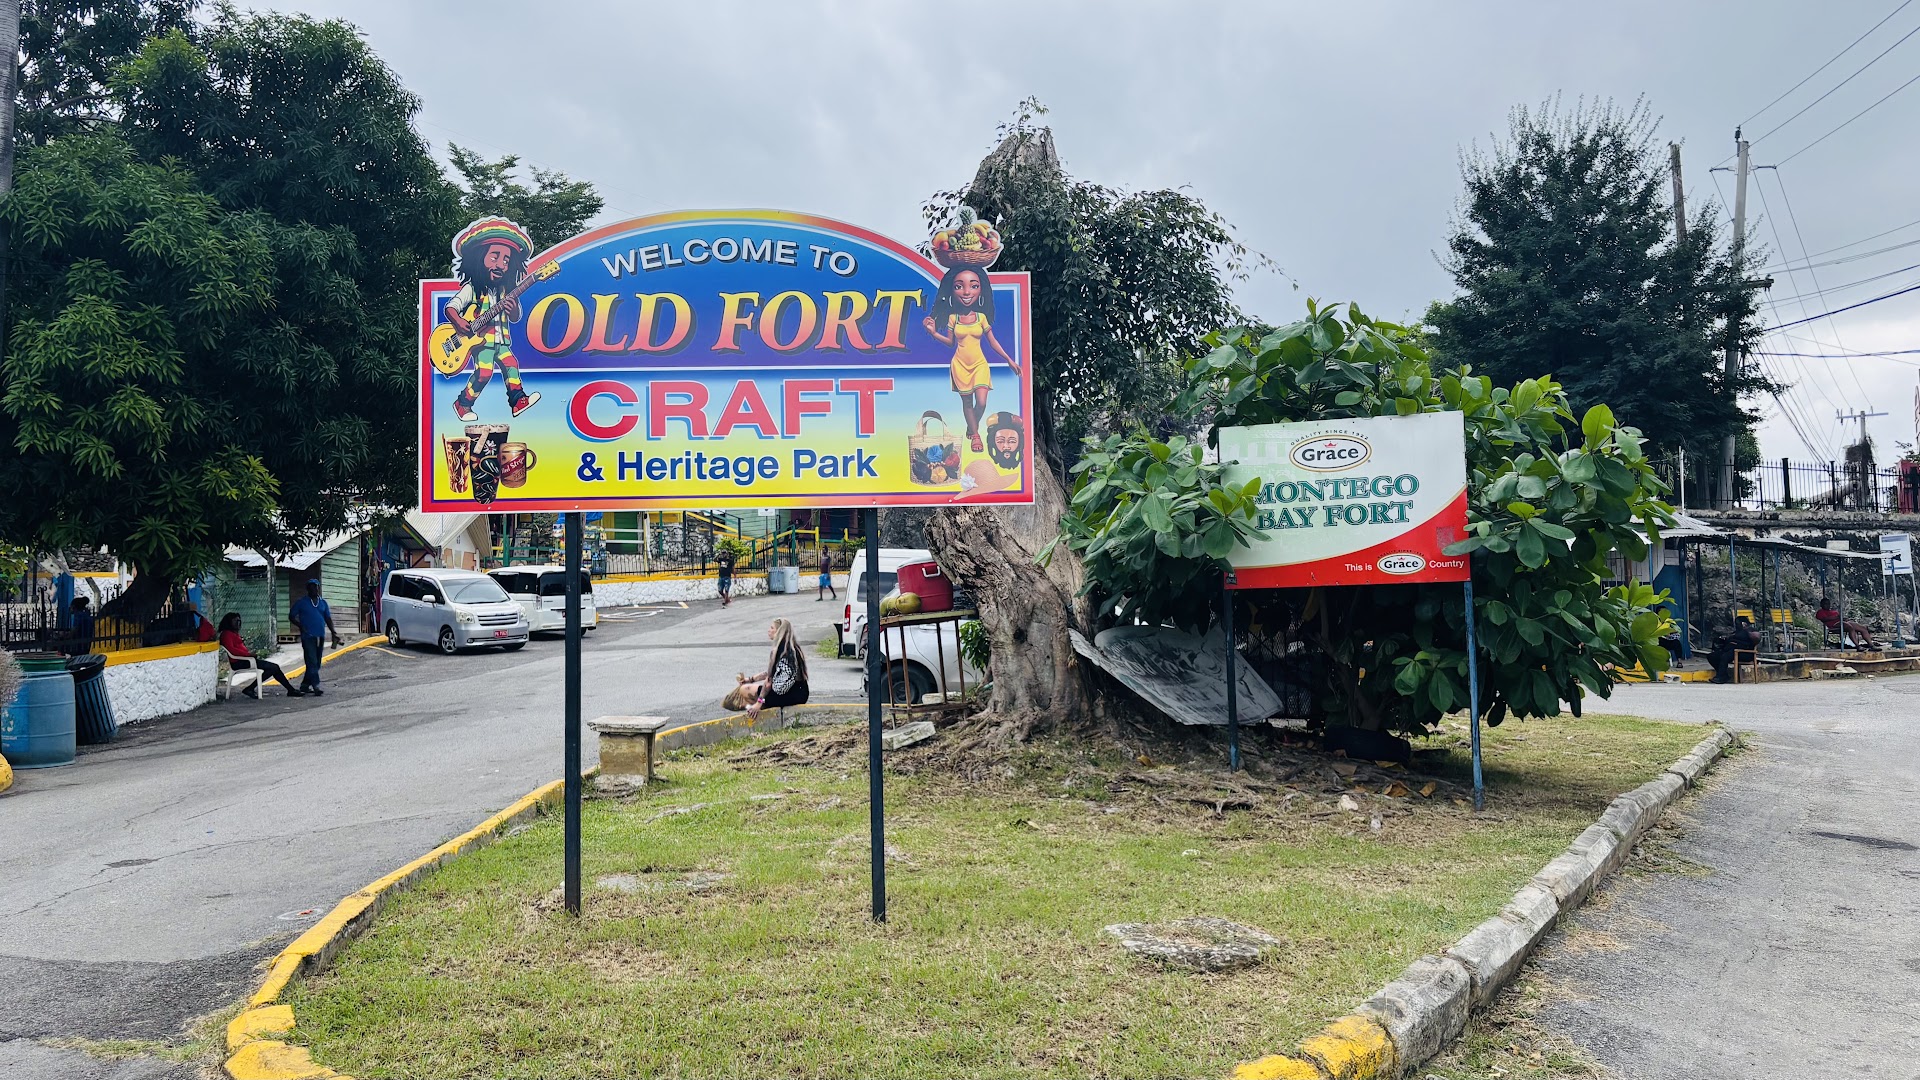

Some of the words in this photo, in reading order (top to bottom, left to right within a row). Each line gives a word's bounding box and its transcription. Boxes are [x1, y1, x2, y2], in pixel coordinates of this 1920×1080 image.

[601, 237, 797, 278] WELCOME
[809, 244, 857, 276] TO
[526, 292, 696, 355] OLD
[711, 289, 922, 353] FORT
[569, 379, 894, 440] CRAFT
[1290, 431, 1322, 446] QUALITY
[1351, 431, 1369, 441] 1922
[576, 451, 605, 482] &
[617, 450, 780, 486] Heritage
[793, 448, 879, 478] Park
[1301, 448, 1359, 462] Grace
[1254, 473, 1420, 505] MONTEGO
[1255, 506, 1318, 531] BAY
[1323, 499, 1414, 528] FORT
[1344, 563, 1363, 572] This
[1365, 562, 1373, 571] is
[1384, 560, 1419, 569] Grace
[1429, 560, 1465, 569] Country
